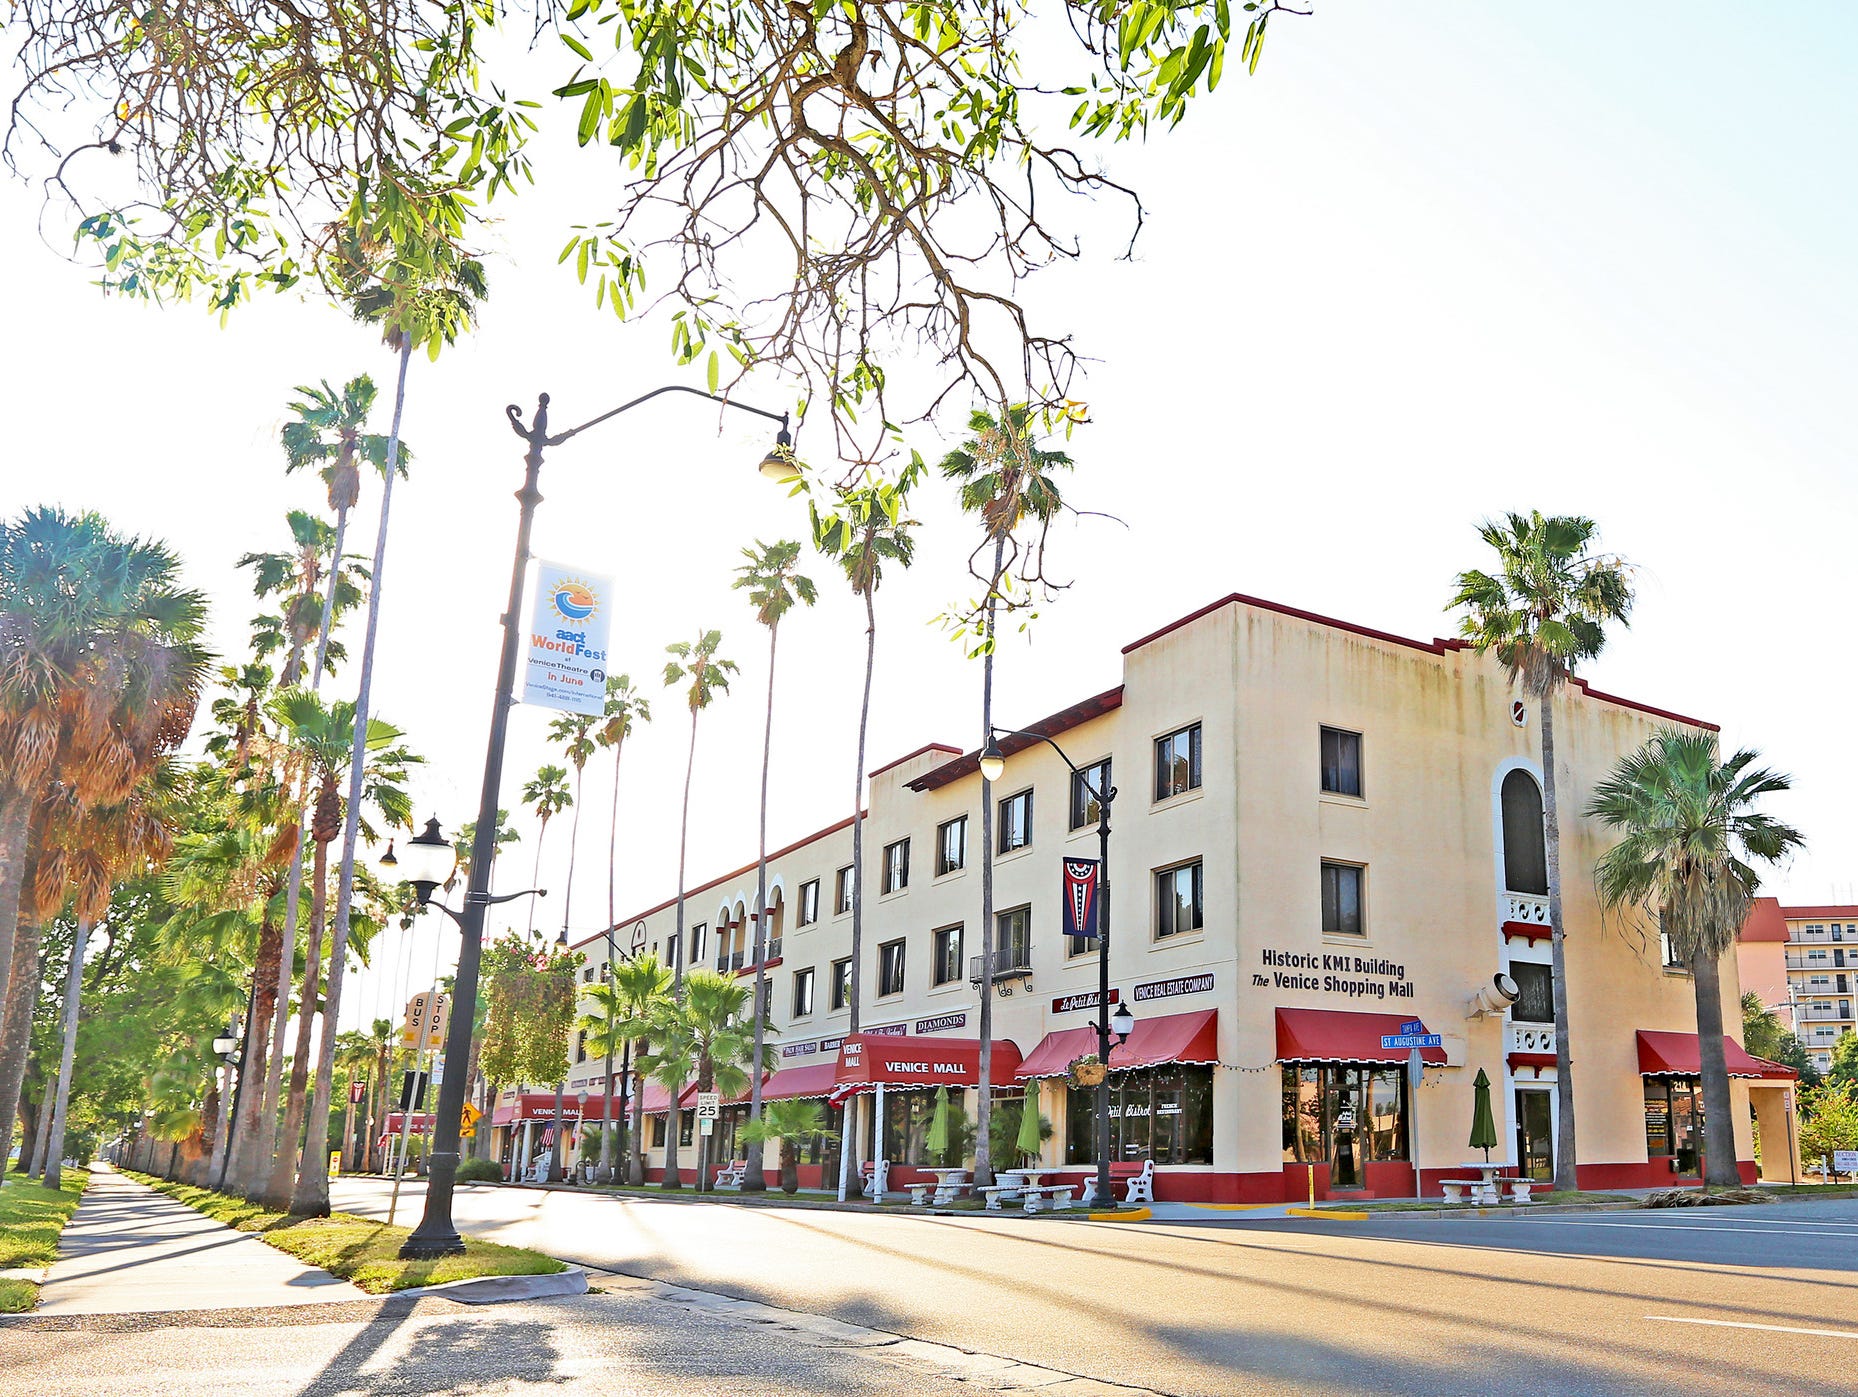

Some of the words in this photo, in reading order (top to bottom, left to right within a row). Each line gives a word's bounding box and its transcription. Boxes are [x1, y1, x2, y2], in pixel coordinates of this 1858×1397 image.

[556, 629, 586, 644] aact
[531, 634, 606, 662] WorldFest
[560, 674, 583, 686] June
[1262, 949, 1319, 969] Historic
[1323, 954, 1351, 972] KMI
[1354, 957, 1405, 980] Building
[1135, 985, 1154, 1000] VENICE
[1154, 983, 1166, 997] REAL
[1167, 981, 1184, 995] ESTATE
[1184, 976, 1213, 993] COMPANY
[1252, 974, 1269, 987] The
[1273, 972, 1319, 990] Venice
[1324, 975, 1385, 1000] Shopping
[1389, 981, 1413, 998] Mall
[1060, 998, 1070, 1011] Le
[1070, 995, 1086, 1011] Petit
[411, 998, 424, 1027] BUS
[430, 995, 444, 1033] STOP
[918, 1015, 964, 1031] DIAMONDS
[843, 1043, 862, 1055] VENICE
[1383, 1037, 1391, 1047] ST
[1394, 1036, 1426, 1047] AUGUSTINE
[1428, 1035, 1440, 1045] AVE
[845, 1056, 860, 1067] MALL
[884, 1062, 929, 1073] VENICE
[933, 1063, 967, 1074] MALL
[699, 1106, 716, 1116] 25
